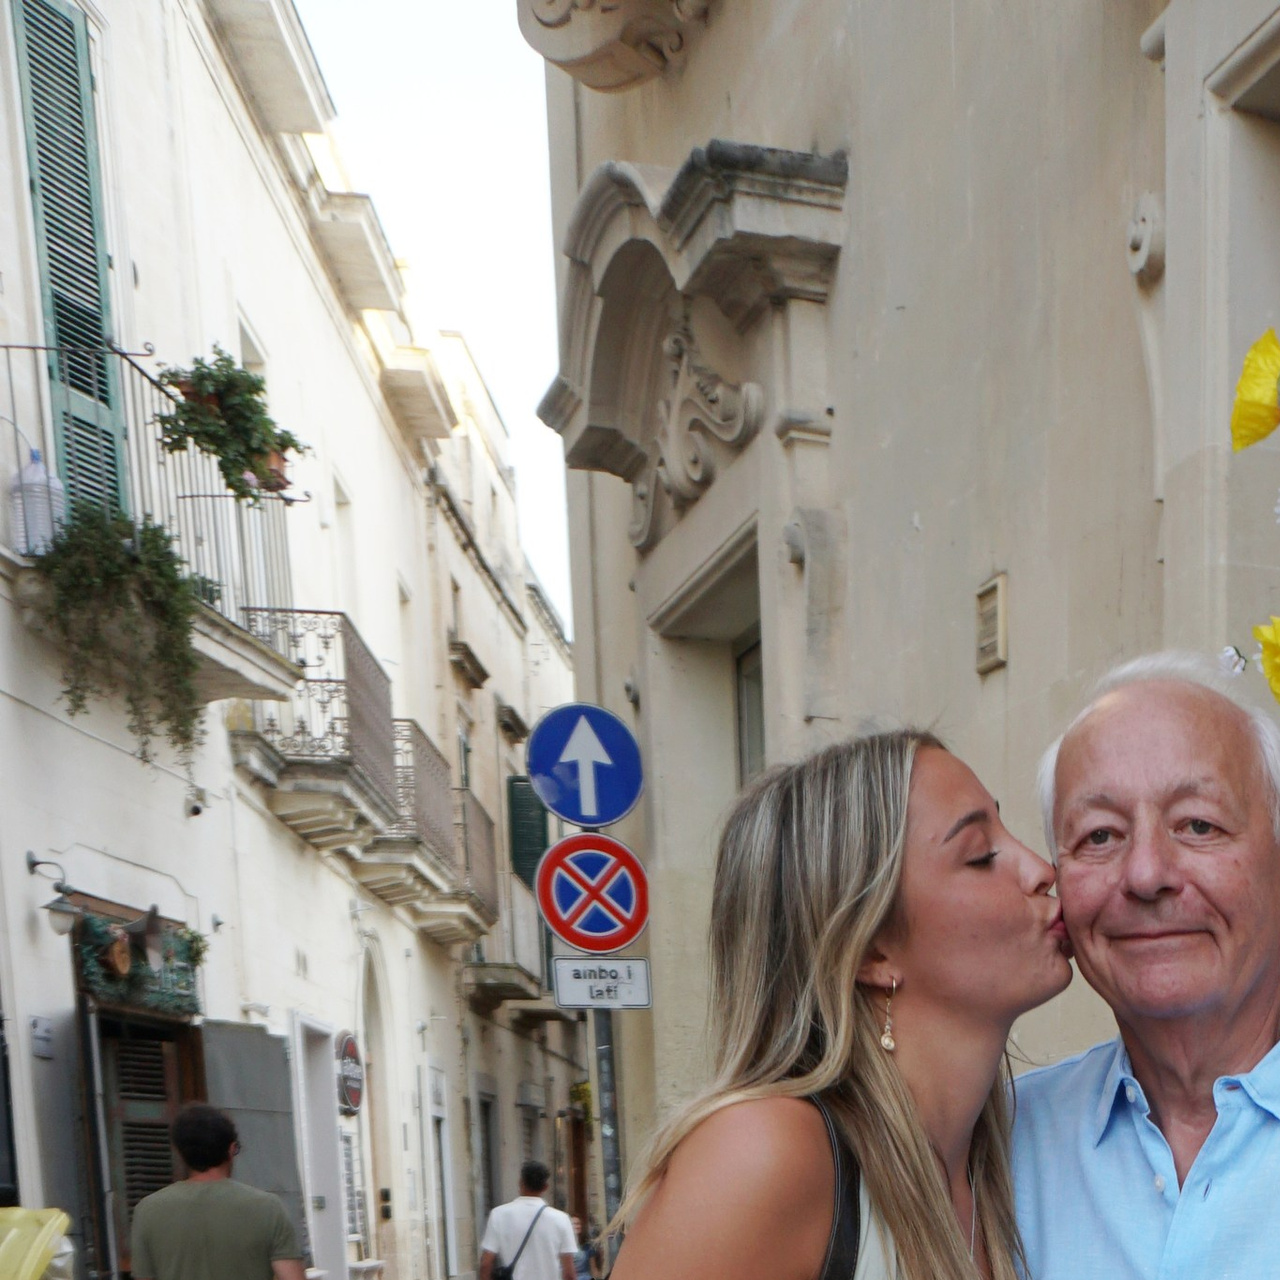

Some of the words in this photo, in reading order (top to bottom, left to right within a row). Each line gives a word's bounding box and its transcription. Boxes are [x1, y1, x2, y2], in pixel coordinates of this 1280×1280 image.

[572, 965, 619, 980] ambo
[626, 965, 632, 980] i
[590, 985, 619, 1000] lati
